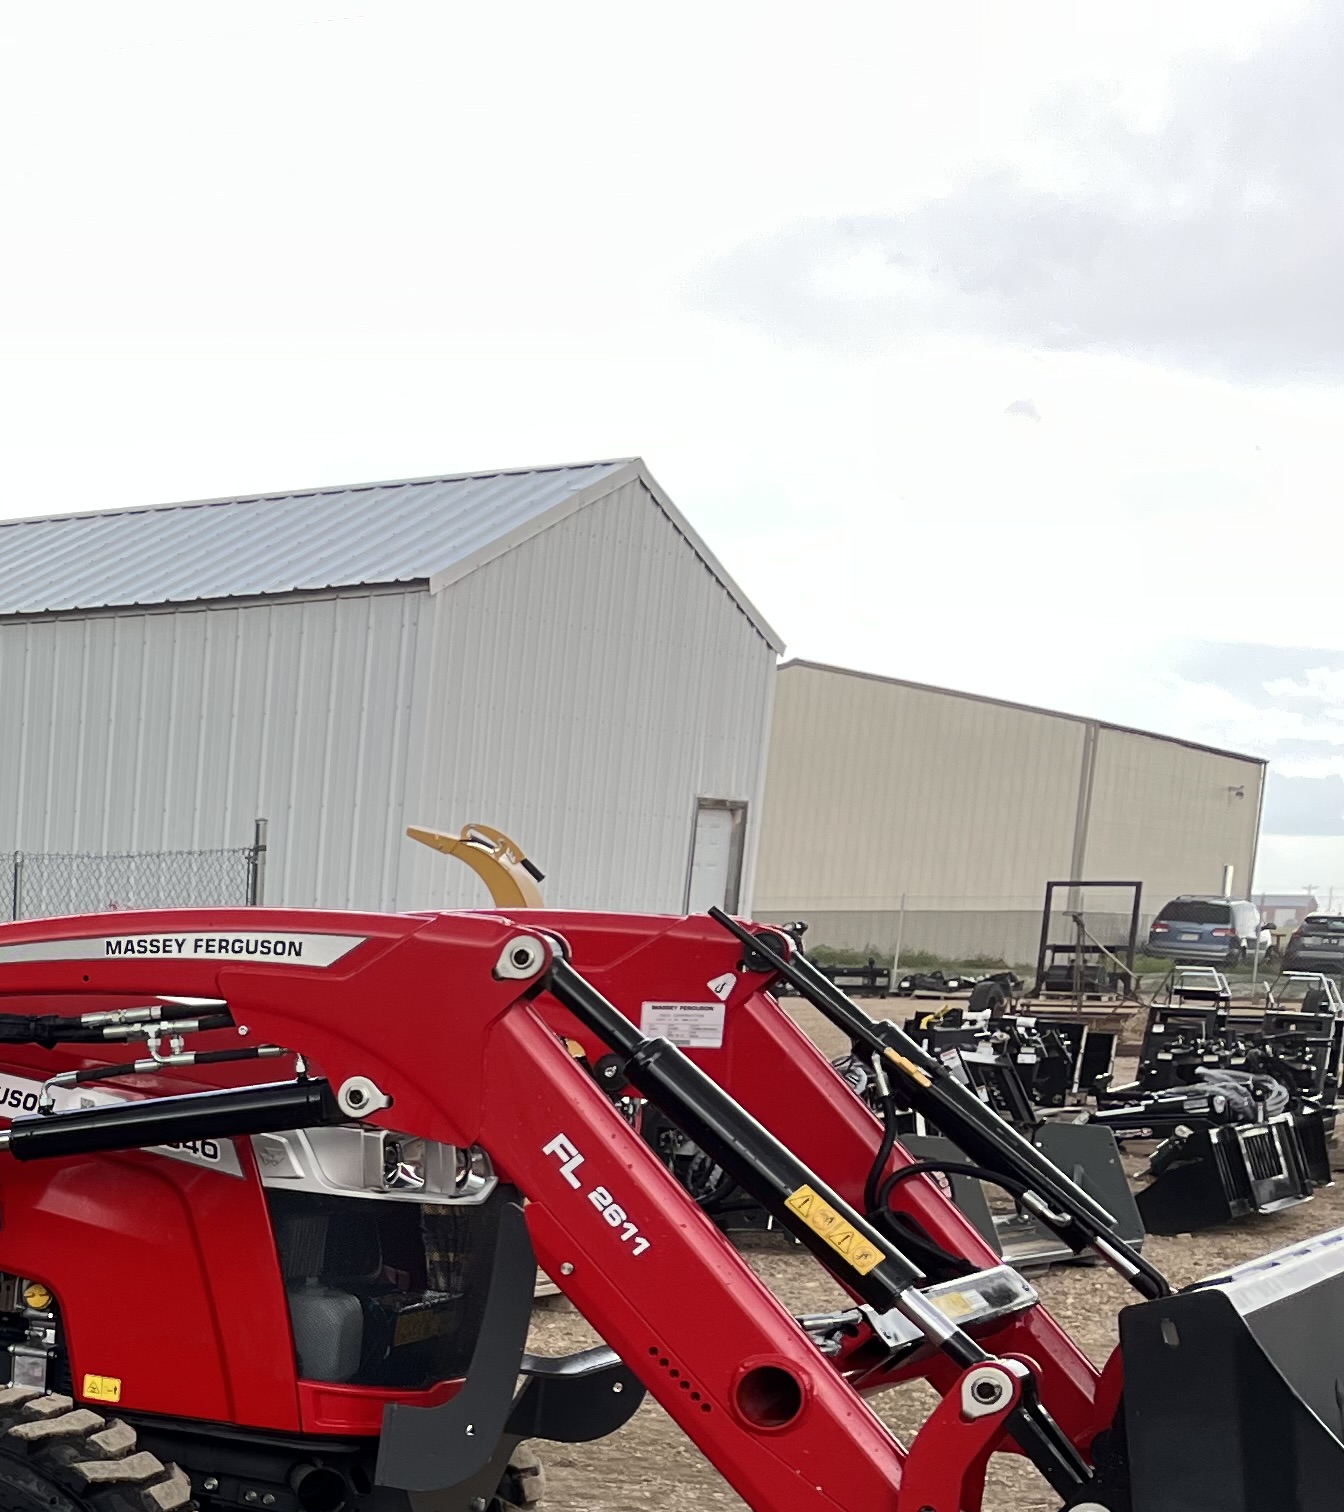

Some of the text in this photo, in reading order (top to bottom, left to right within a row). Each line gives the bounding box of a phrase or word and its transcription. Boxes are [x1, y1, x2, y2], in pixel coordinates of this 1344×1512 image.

[105, 938, 303, 957] MASSEY FERGUSON
[542, 1132, 651, 1256] FL 2611
